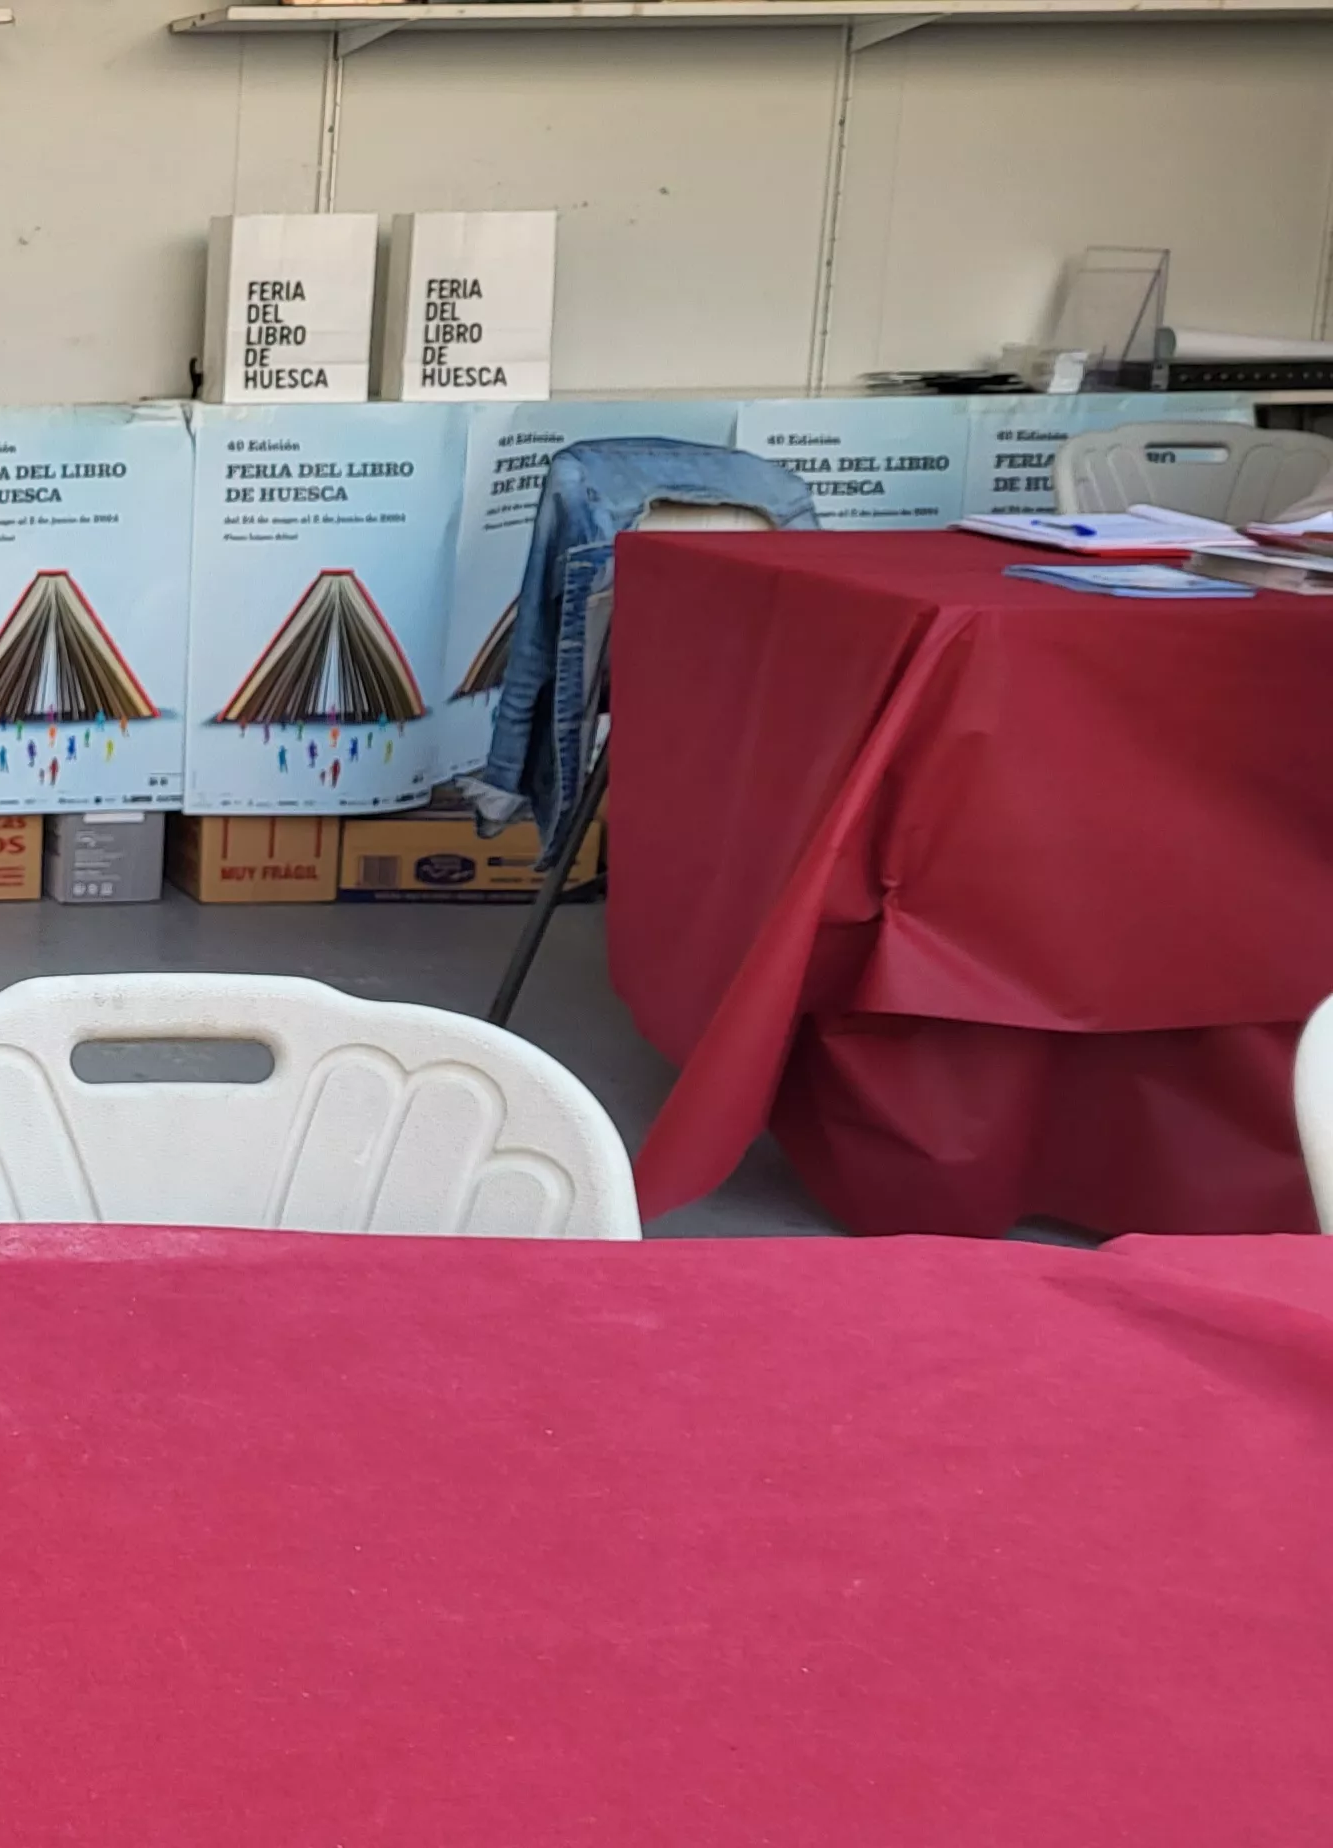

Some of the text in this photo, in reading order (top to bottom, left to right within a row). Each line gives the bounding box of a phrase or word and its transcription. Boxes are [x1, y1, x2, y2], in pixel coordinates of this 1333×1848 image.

[249, 282, 306, 301] FERIA
[427, 279, 482, 299] FERIA
[248, 304, 283, 324] DEL
[425, 302, 460, 321] DEL
[246, 326, 306, 345] LIBRO
[424, 324, 482, 343] LIBRO
[245, 348, 270, 366] DE
[423, 346, 447, 365] DE
[244, 369, 328, 389] HUESCA
[421, 367, 507, 387] HUESCA
[248, 439, 300, 451] Edición
[16, 464, 55, 480] DEL
[61, 462, 126, 479] LIBRO
[226, 461, 414, 479] FERIA DEL LIBRO
[837, 456, 880, 472] DEL
[884, 455, 949, 471] LIBRO
[225, 486, 348, 502] DE HUESCA
[993, 477, 1020, 493] DE
[221, 862, 318, 881] MUY FRÁGIL
